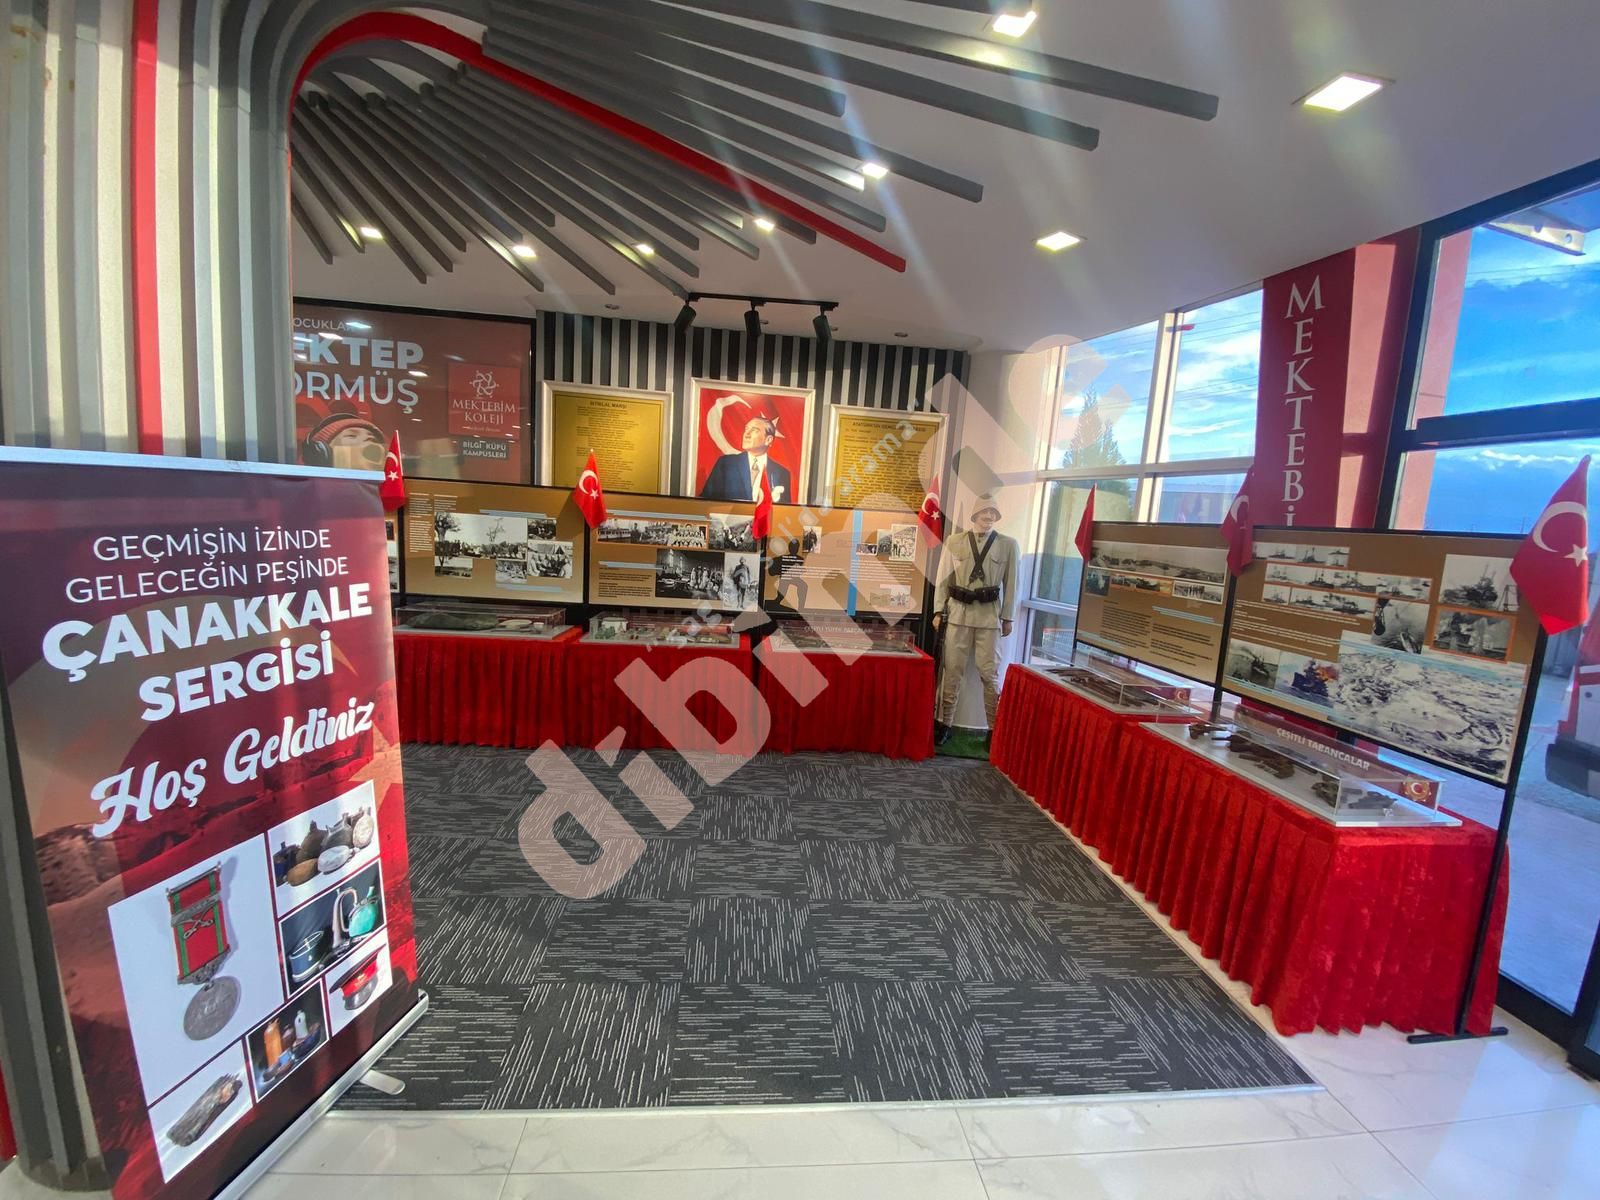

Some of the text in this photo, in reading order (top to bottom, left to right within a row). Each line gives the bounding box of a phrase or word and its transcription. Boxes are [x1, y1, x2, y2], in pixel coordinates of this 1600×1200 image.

[65, 555, 349, 603] GELECEĞİN PEŞİNDE
[93, 525, 332, 564] GEÇMİŞİN İZİNDE
[42, 582, 372, 683] ÇANAKKALE
[139, 629, 333, 722] SERGİSİ
[90, 696, 375, 839] Hoş Geldiniz
[1308, 739, 1371, 771] TABANCALAR
